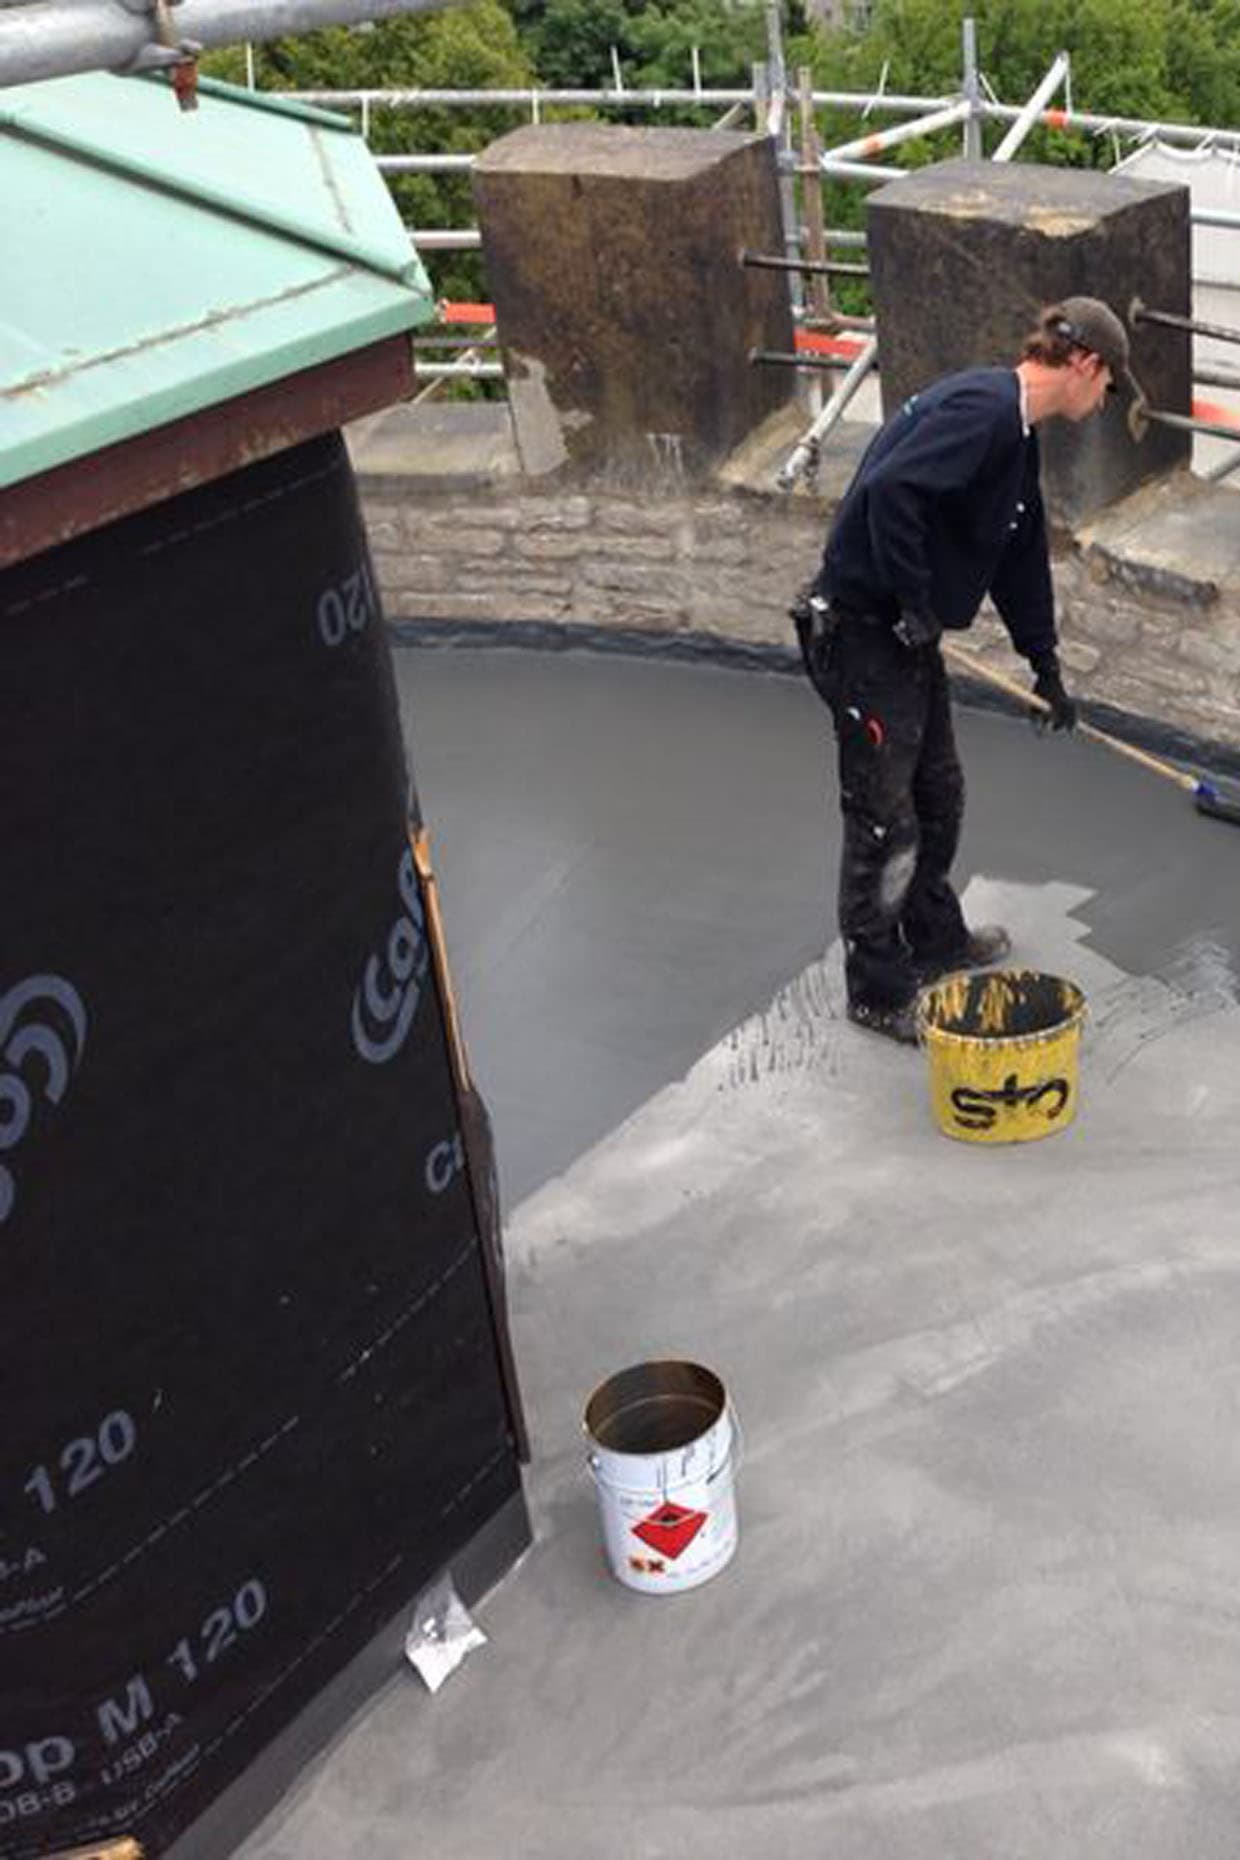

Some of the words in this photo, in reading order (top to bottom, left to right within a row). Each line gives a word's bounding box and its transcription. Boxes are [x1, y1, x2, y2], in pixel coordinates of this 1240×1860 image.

[24, 1408, 138, 1515] 120
[97, 1673, 156, 1745] M
[164, 1578, 267, 1682] 120
